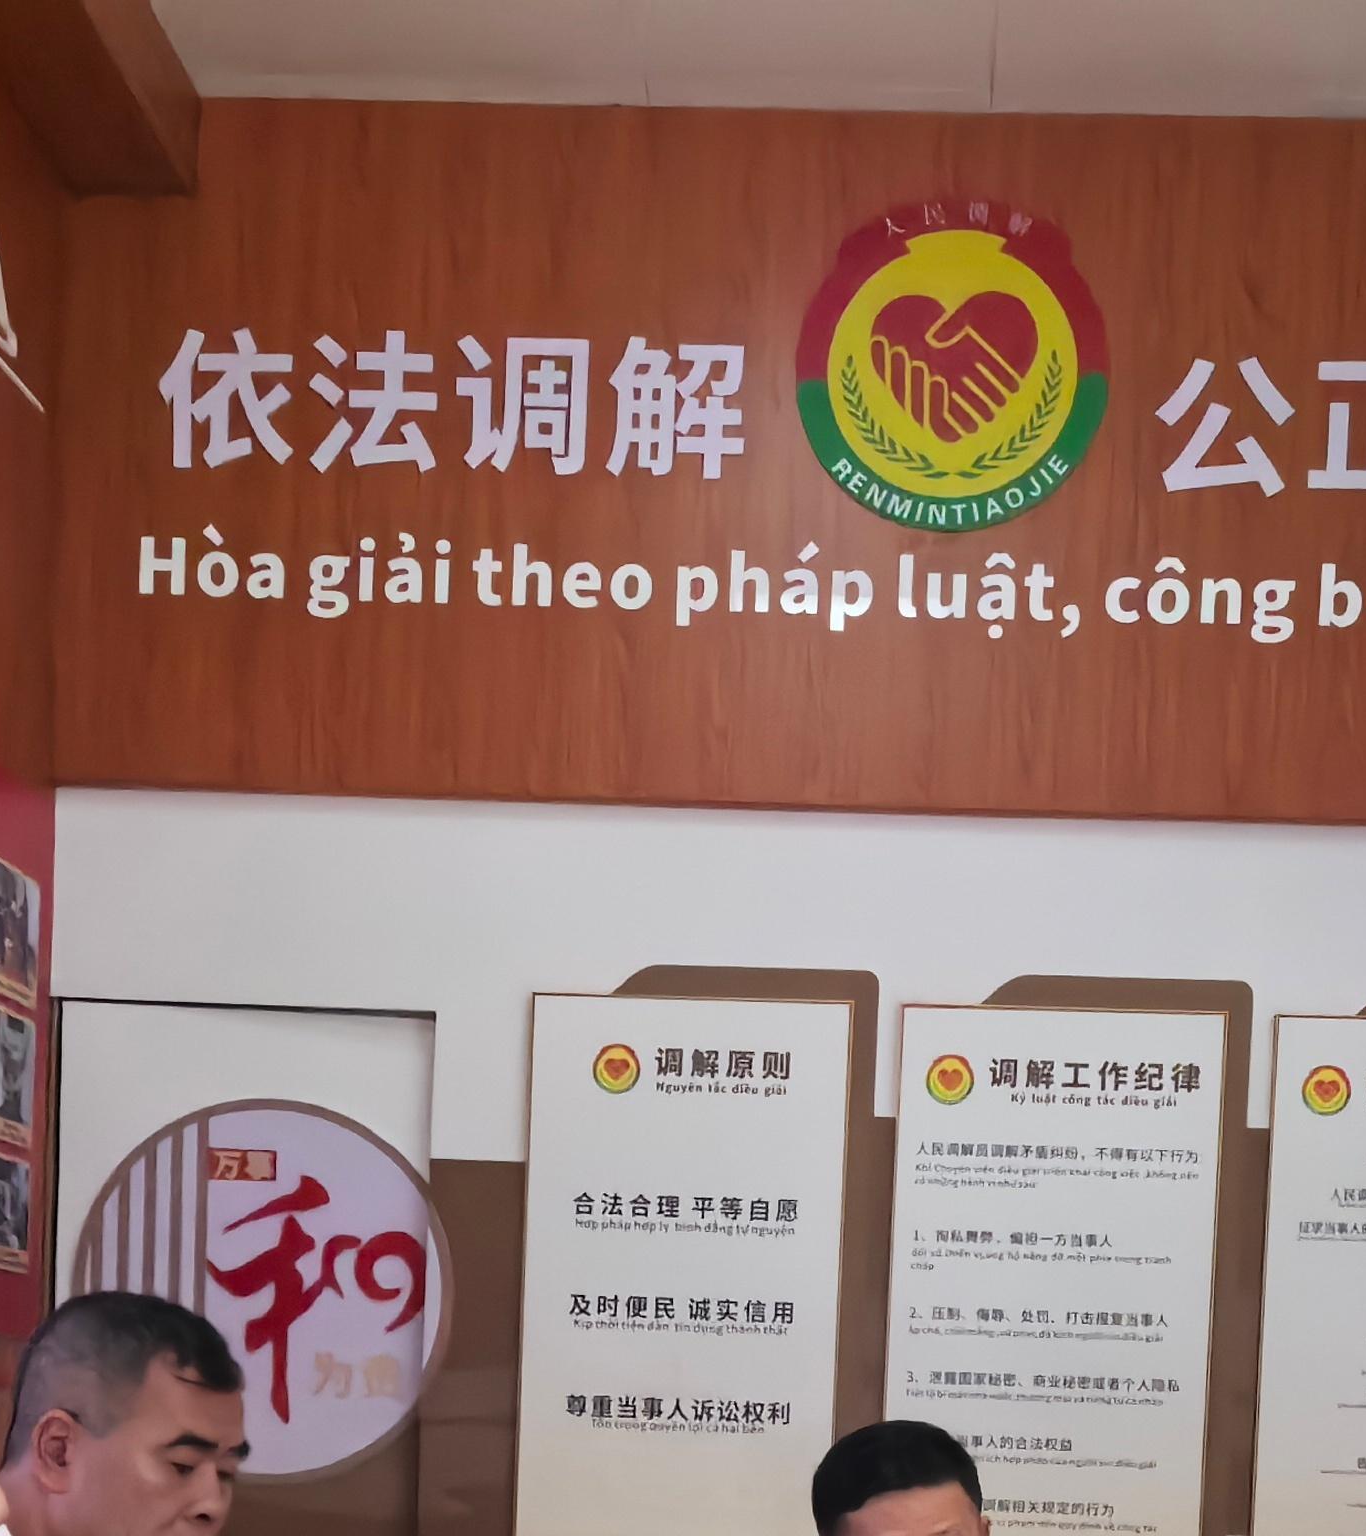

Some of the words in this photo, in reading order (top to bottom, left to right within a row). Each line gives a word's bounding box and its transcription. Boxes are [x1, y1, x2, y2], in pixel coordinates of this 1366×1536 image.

[159, 328, 745, 479] 依法调解
[832, 454, 1069, 526] RENMINTIAOJIE
[139, 523, 286, 599] Hòa
[307, 532, 450, 618] giải
[473, 543, 653, 610] theo
[676, 541, 874, 632] pháp
[898, 552, 1080, 639] luật,
[1105, 556, 1296, 644] công
[654, 1047, 791, 1080] 调解原则
[989, 1058, 1201, 1093] 调解工作纪律
[573, 1192, 680, 1218] 合法合理
[692, 1197, 799, 1222] 平等自愿
[569, 1294, 675, 1319] 及时便民
[688, 1298, 794, 1325] 诚实信用
[566, 1394, 790, 1425] 尊重当事人诉讼权利
